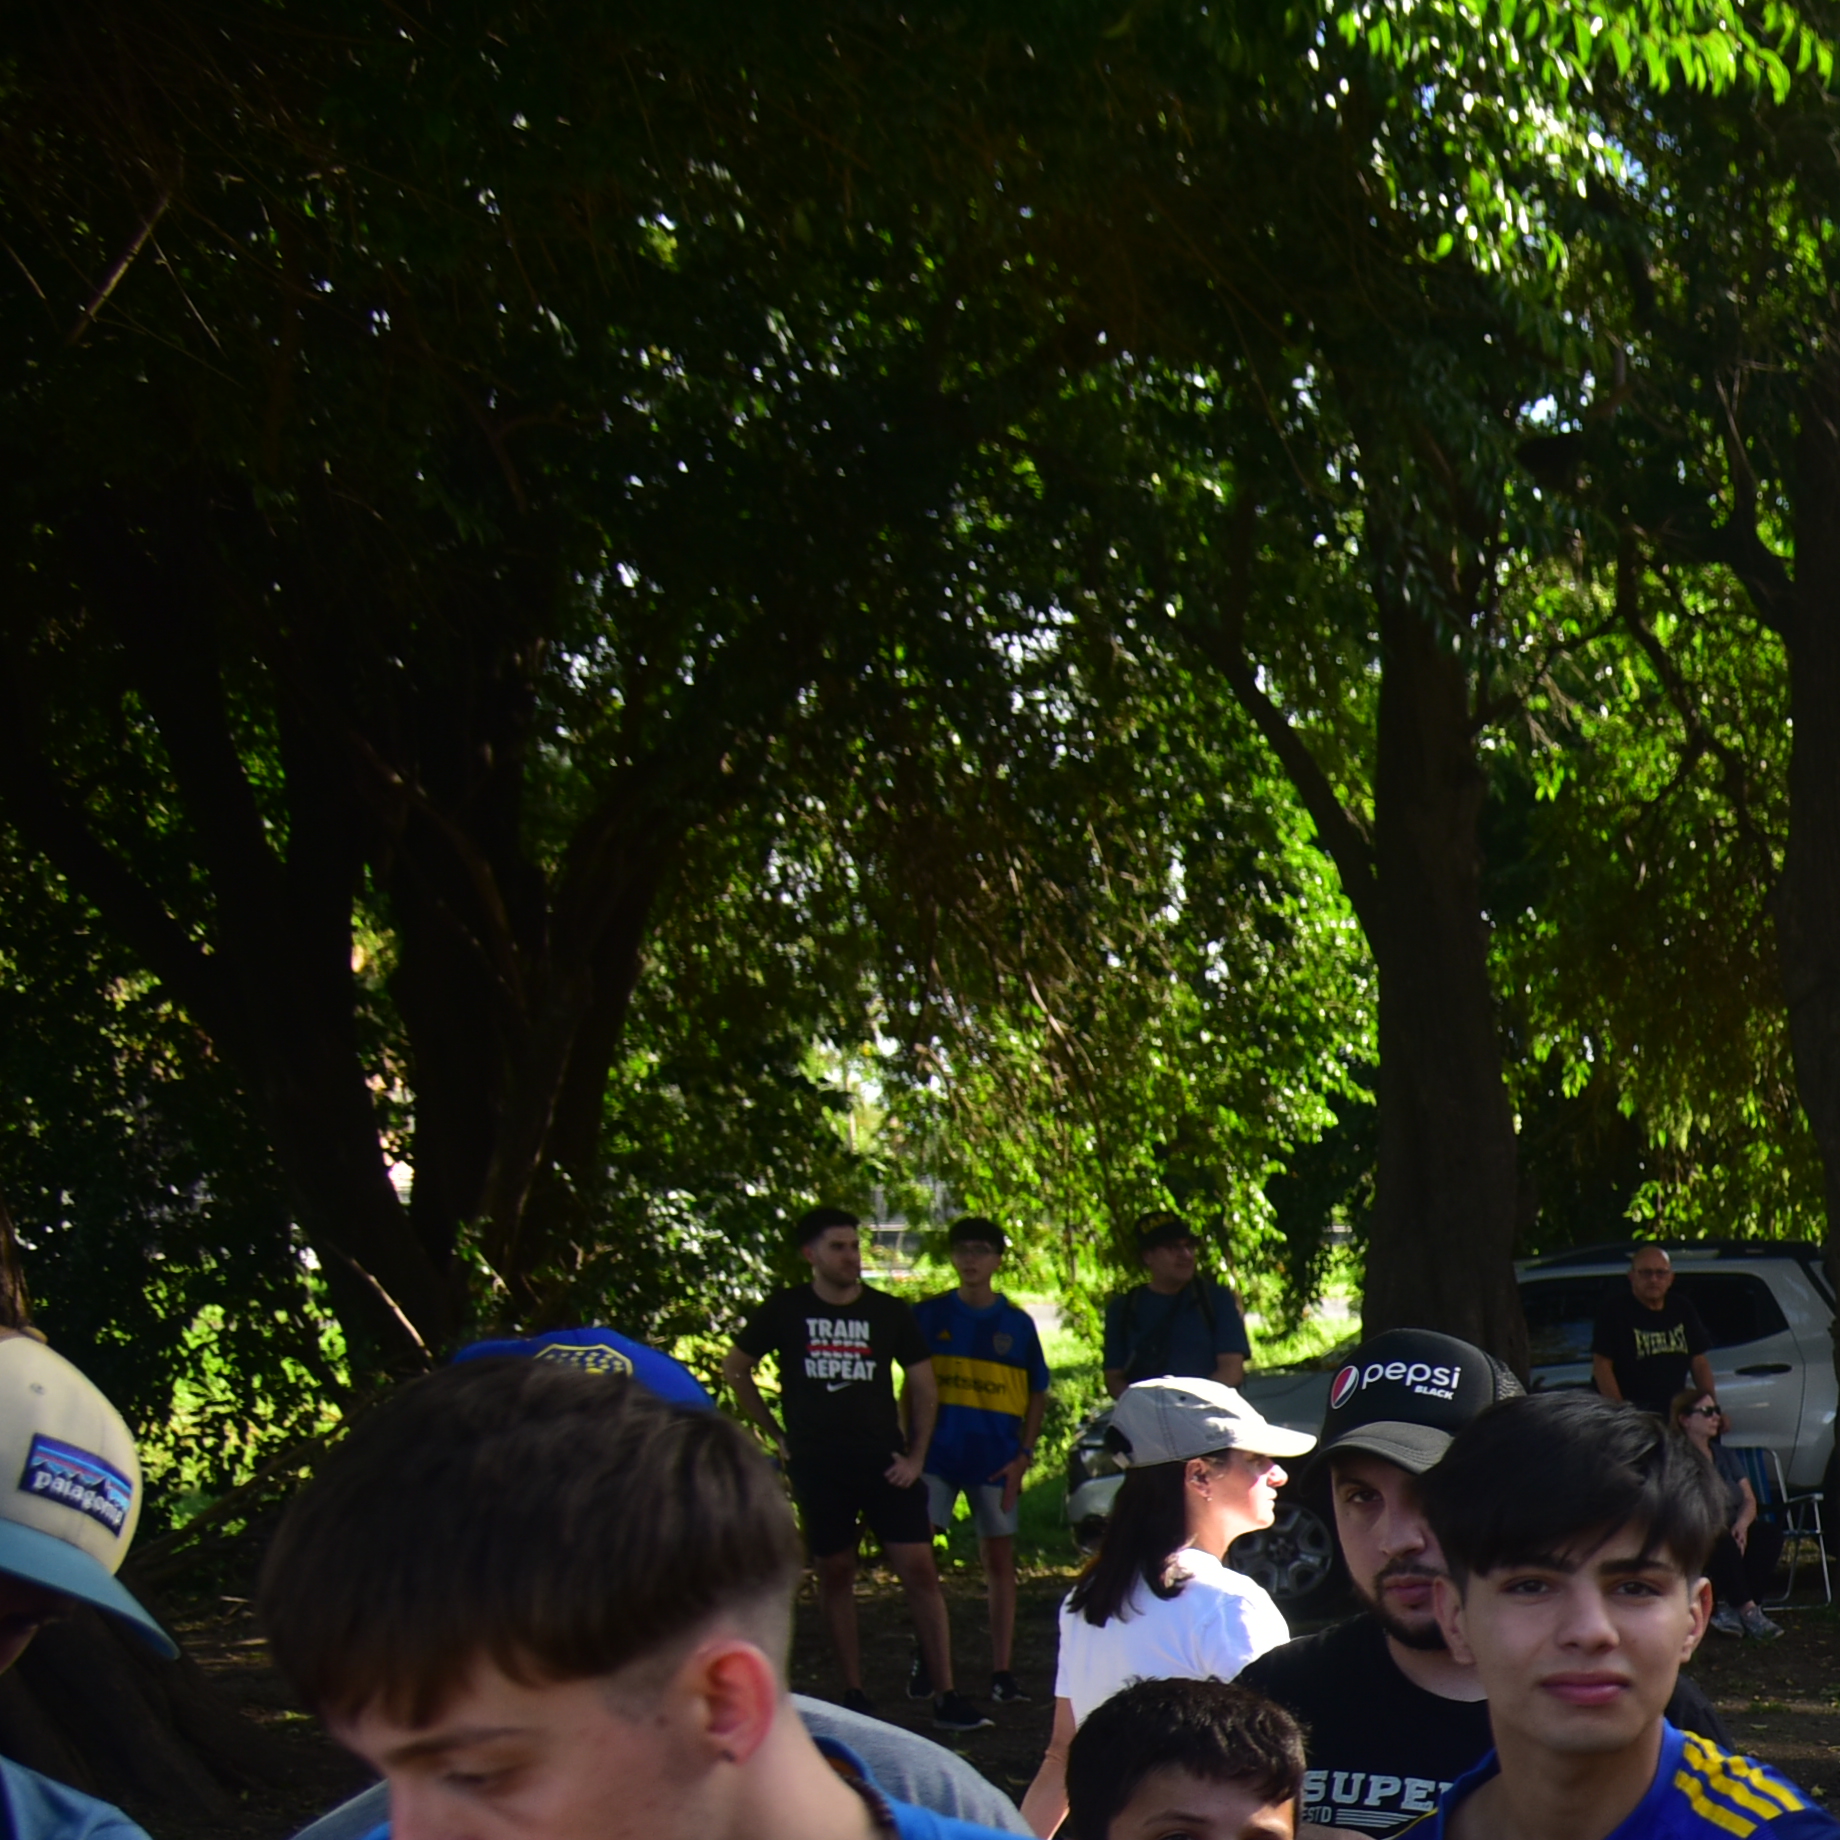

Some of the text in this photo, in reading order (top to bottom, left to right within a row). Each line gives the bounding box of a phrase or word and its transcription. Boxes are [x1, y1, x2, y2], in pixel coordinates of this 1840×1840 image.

[805, 1318, 869, 1340] TRAIN
[804, 1358, 876, 1381] REPEAT
[1361, 1362, 1461, 1390] pepsi
[1414, 1385, 1455, 1400] BLACK
